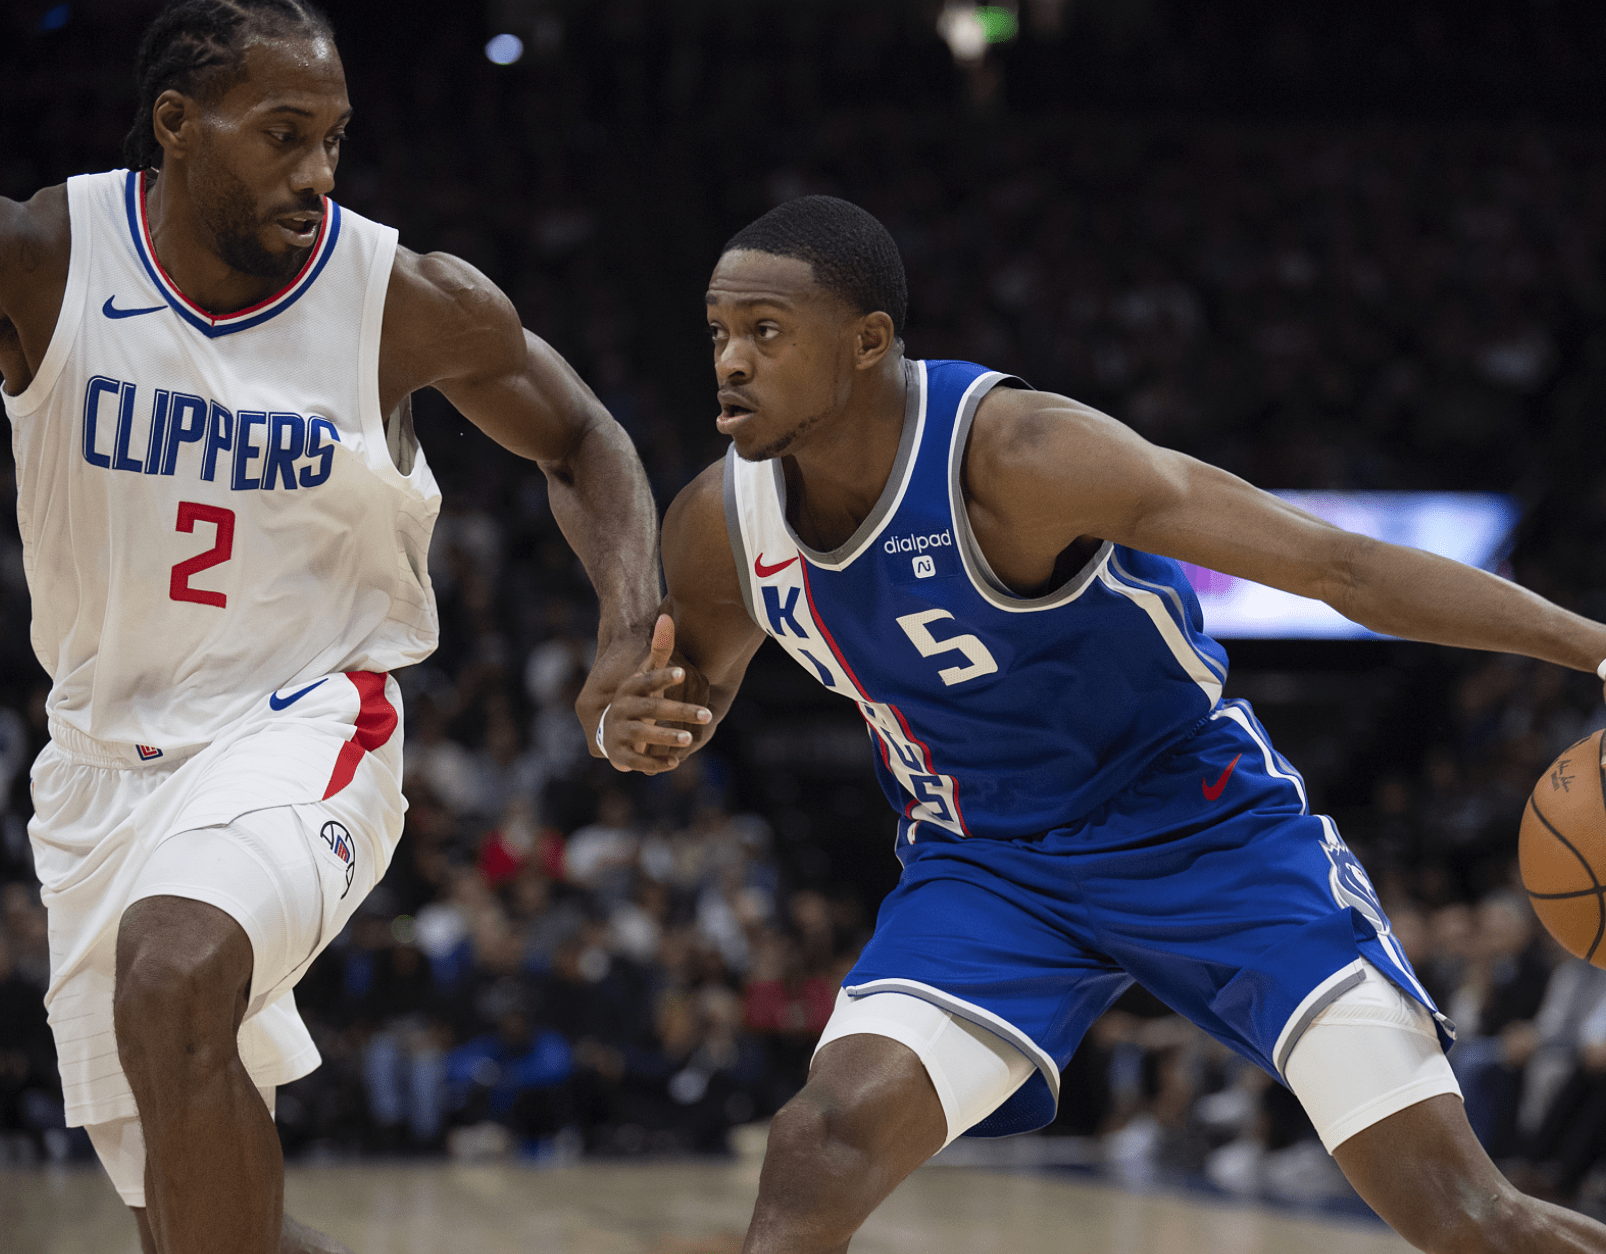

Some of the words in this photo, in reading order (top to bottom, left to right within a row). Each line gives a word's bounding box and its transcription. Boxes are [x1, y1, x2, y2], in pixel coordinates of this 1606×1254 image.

[82, 375, 341, 491] CLIPPERS
[169, 501, 236, 609] 2
[884, 528, 952, 554] dialpad
[896, 608, 999, 686] 5
